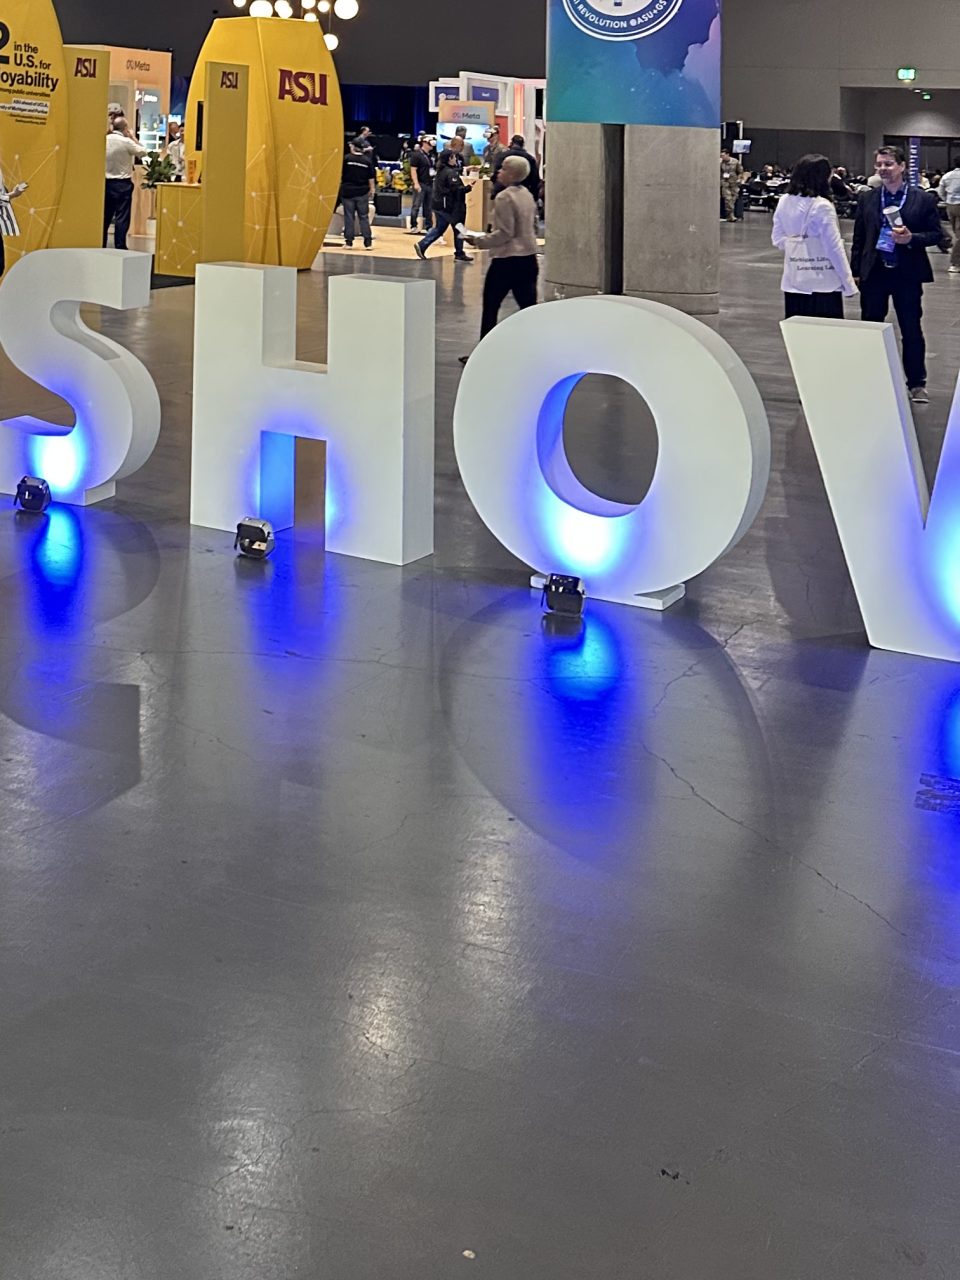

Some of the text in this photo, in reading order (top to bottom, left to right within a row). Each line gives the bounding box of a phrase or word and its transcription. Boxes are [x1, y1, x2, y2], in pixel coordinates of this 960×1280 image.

[578, 4, 627, 28] REVOLUTION
[14, 42, 38, 54] in the
[14, 53, 51, 69] U.S. for
[74, 57, 96, 78] ASU
[134, 61, 151, 71] Meta
[220, 71, 238, 89] ASU
[278, 68, 328, 106] ASU
[462, 112, 481, 120] Meta
